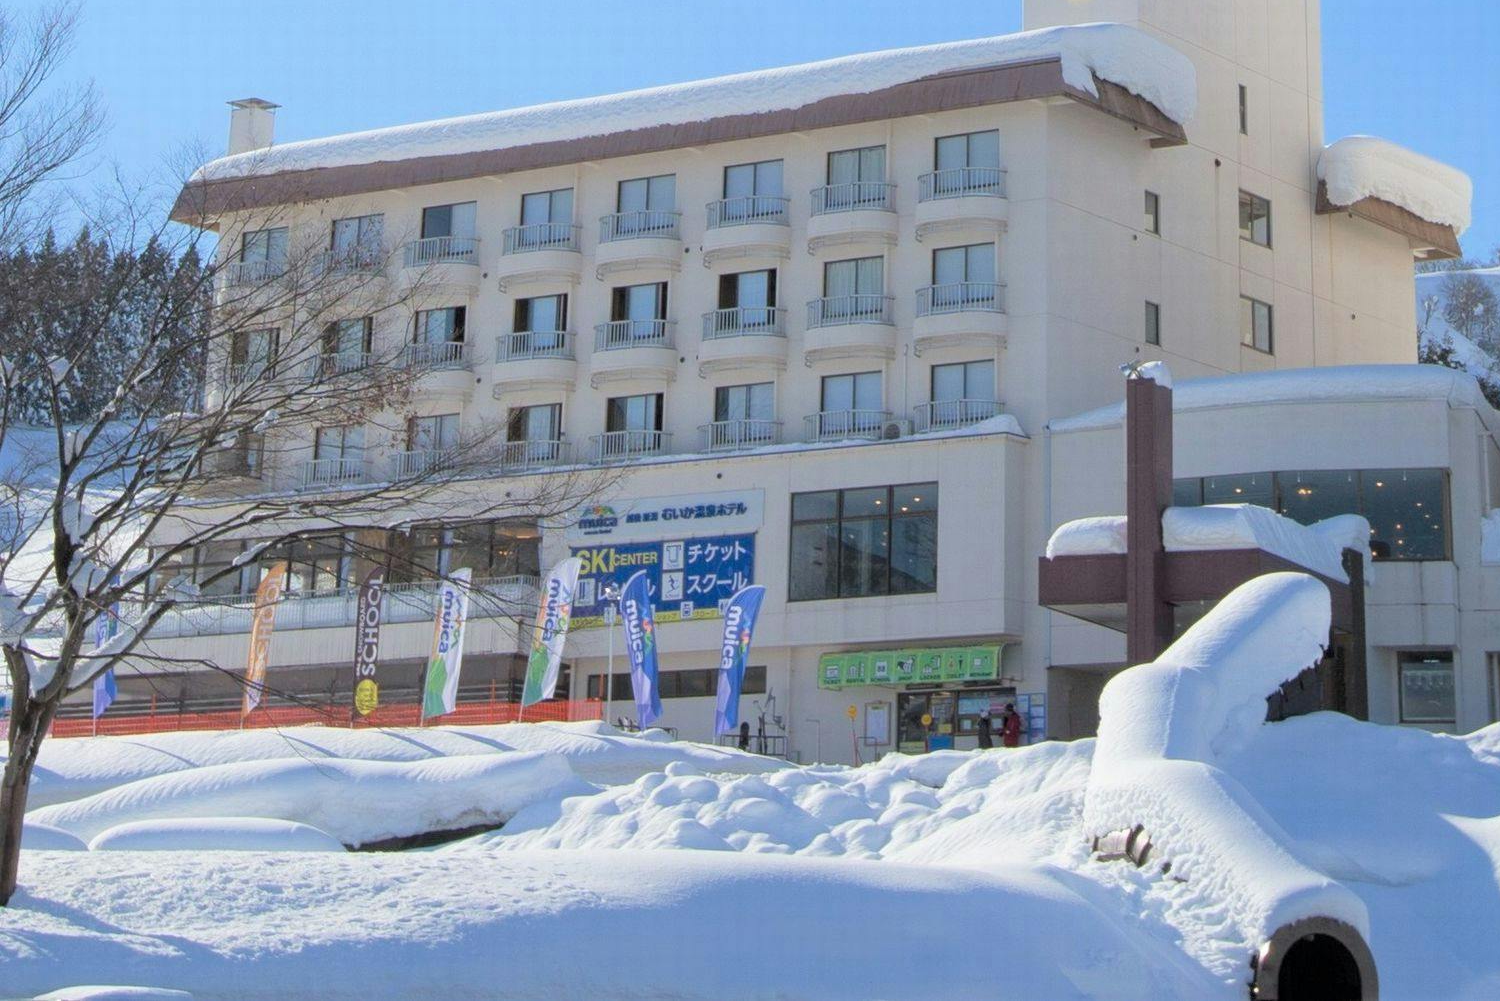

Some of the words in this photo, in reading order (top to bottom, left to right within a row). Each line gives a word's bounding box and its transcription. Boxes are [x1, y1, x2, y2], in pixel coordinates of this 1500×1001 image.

[575, 548, 616, 575] SKI
[614, 551, 658, 567] CENTER
[687, 571, 748, 594] スクール
[688, 540, 746, 564] チケット
[362, 574, 383, 676] SCHOOL
[438, 591, 454, 654] muica
[542, 579, 561, 642] muica
[625, 599, 643, 665] muica
[721, 605, 742, 670] muica
